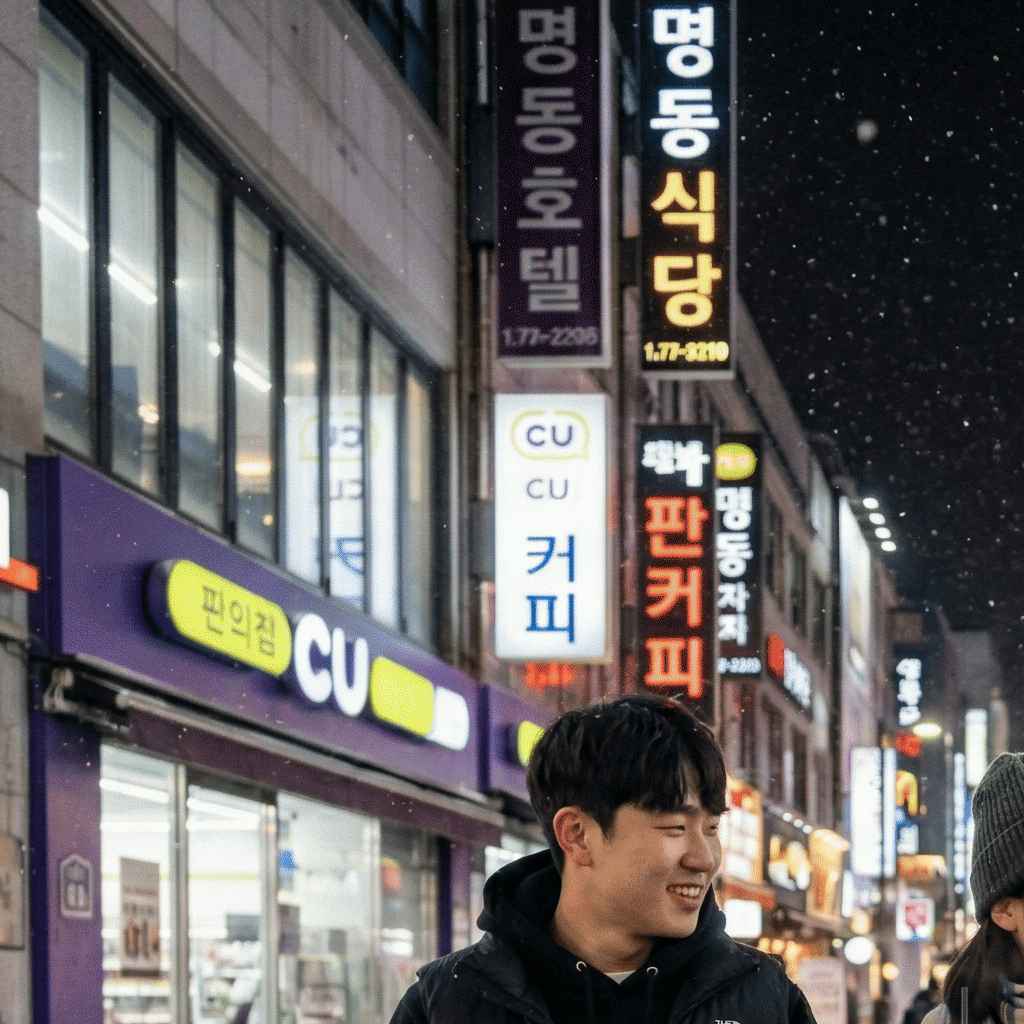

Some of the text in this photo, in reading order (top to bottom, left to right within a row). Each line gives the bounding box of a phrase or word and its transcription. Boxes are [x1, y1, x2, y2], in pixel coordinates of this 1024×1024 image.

[515, 7, 583, 312] 명동호텔
[650, 6, 722, 327] 명동식당
[527, 425, 573, 447] CU
[527, 478, 568, 500] CU
[526, 535, 575, 642] 커피
[645, 496, 710, 698] 판커피
[295, 613, 369, 717] CU
